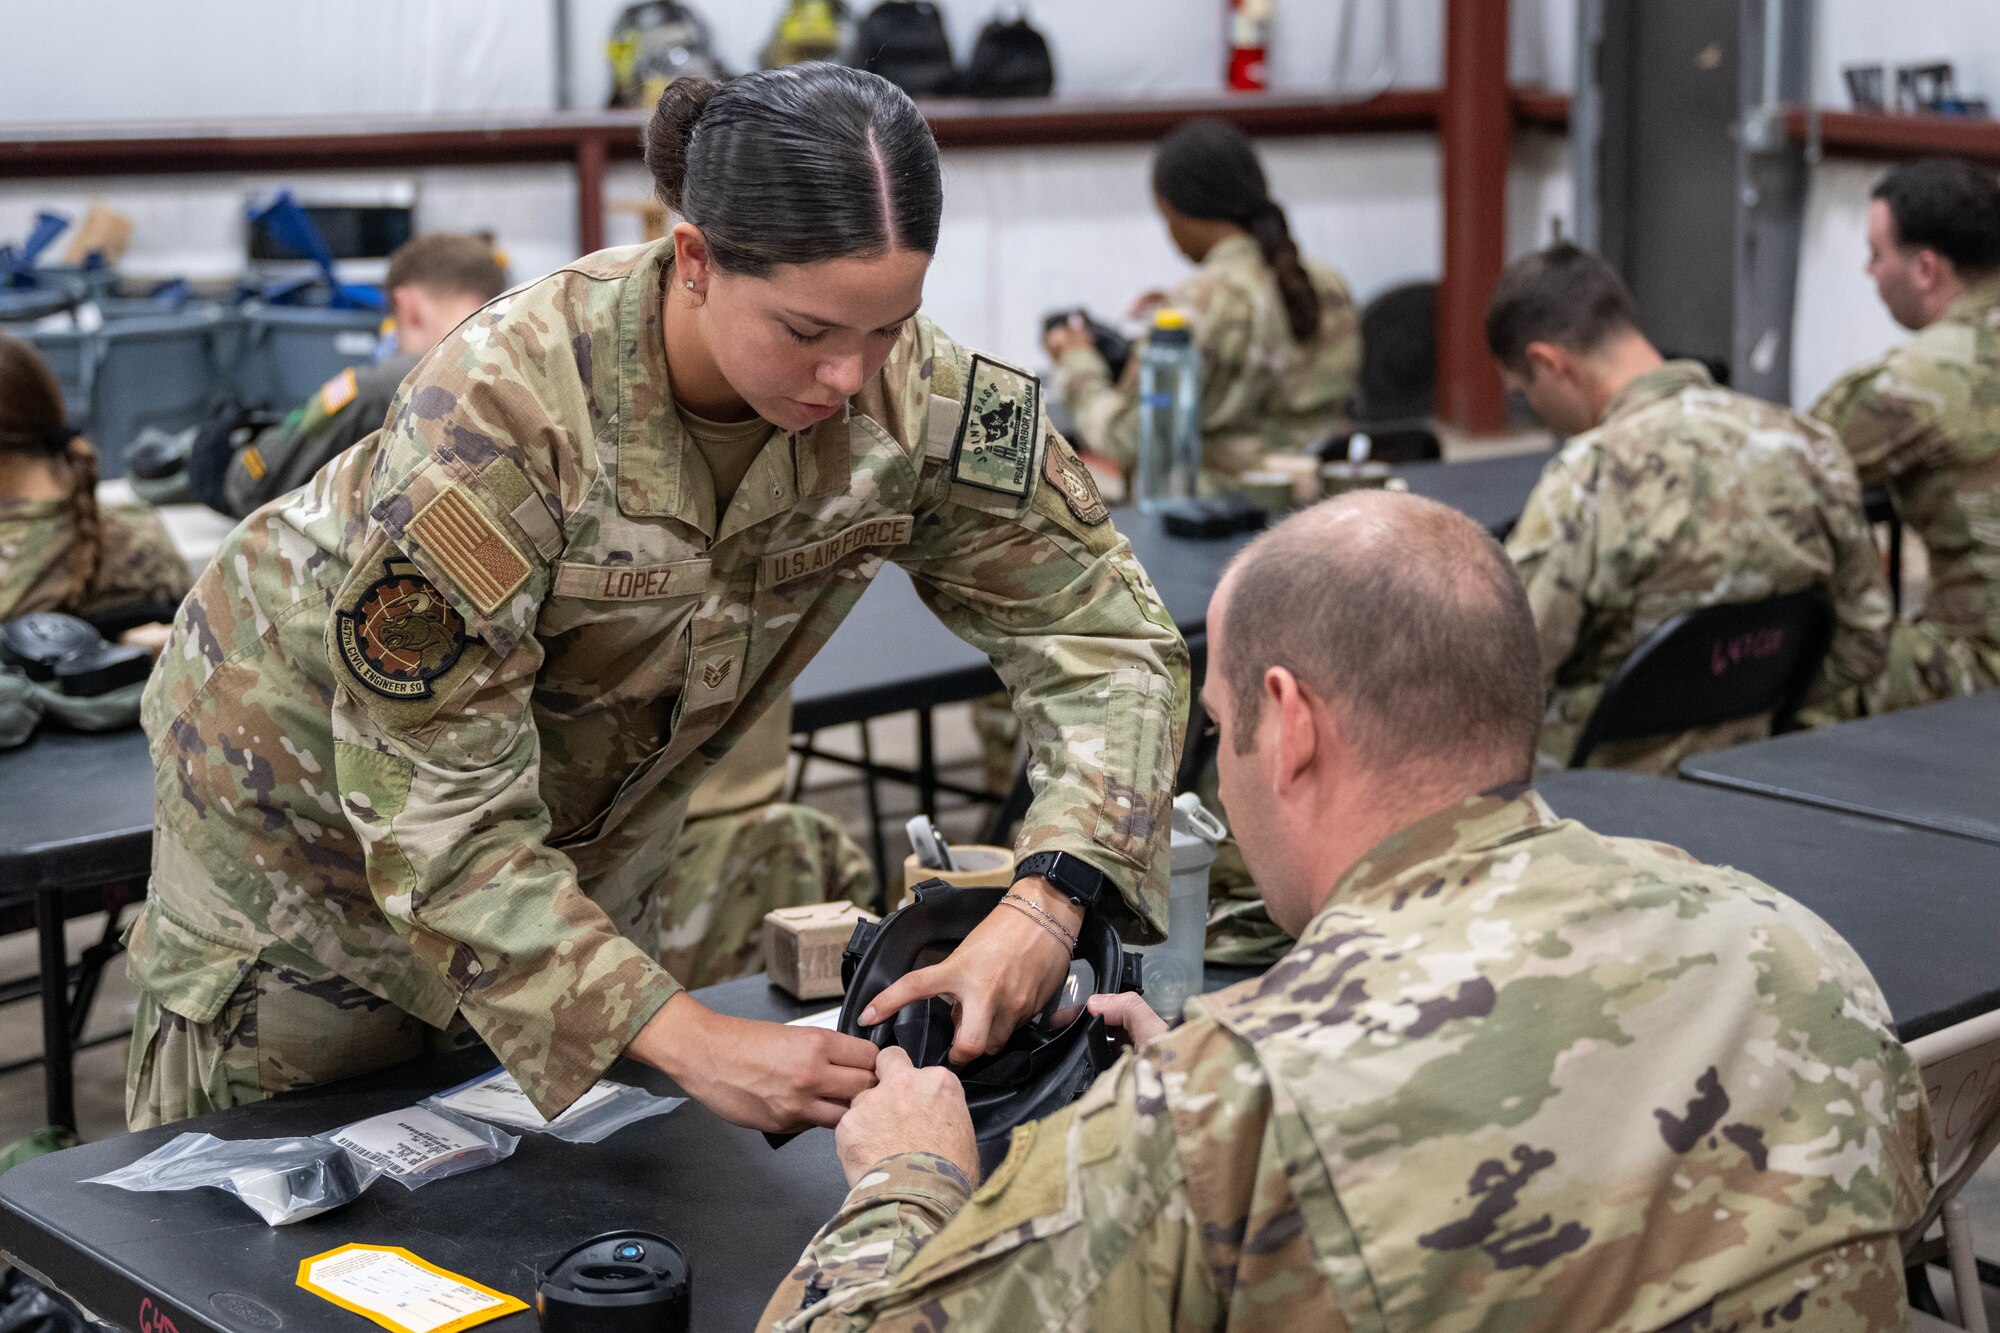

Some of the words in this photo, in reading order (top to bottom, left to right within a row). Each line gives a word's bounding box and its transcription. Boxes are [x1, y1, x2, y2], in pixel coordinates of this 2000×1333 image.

[974, 383, 998, 414] BASE
[1023, 385, 1033, 416] HICKAM
[970, 420, 987, 463] JOINT
[1019, 417, 1030, 451] HARBOR
[1014, 453, 1026, 485] PEARL
[774, 555, 809, 581] U.S.
[811, 542, 839, 569] AIR
[843, 520, 905, 551] FORCE
[602, 568, 671, 598] LOPEZ
[343, 619, 352, 646] 647TH
[347, 647, 364, 671] CIVIL
[363, 670, 407, 692] ENGINEER
[410, 683, 422, 692] SQ
